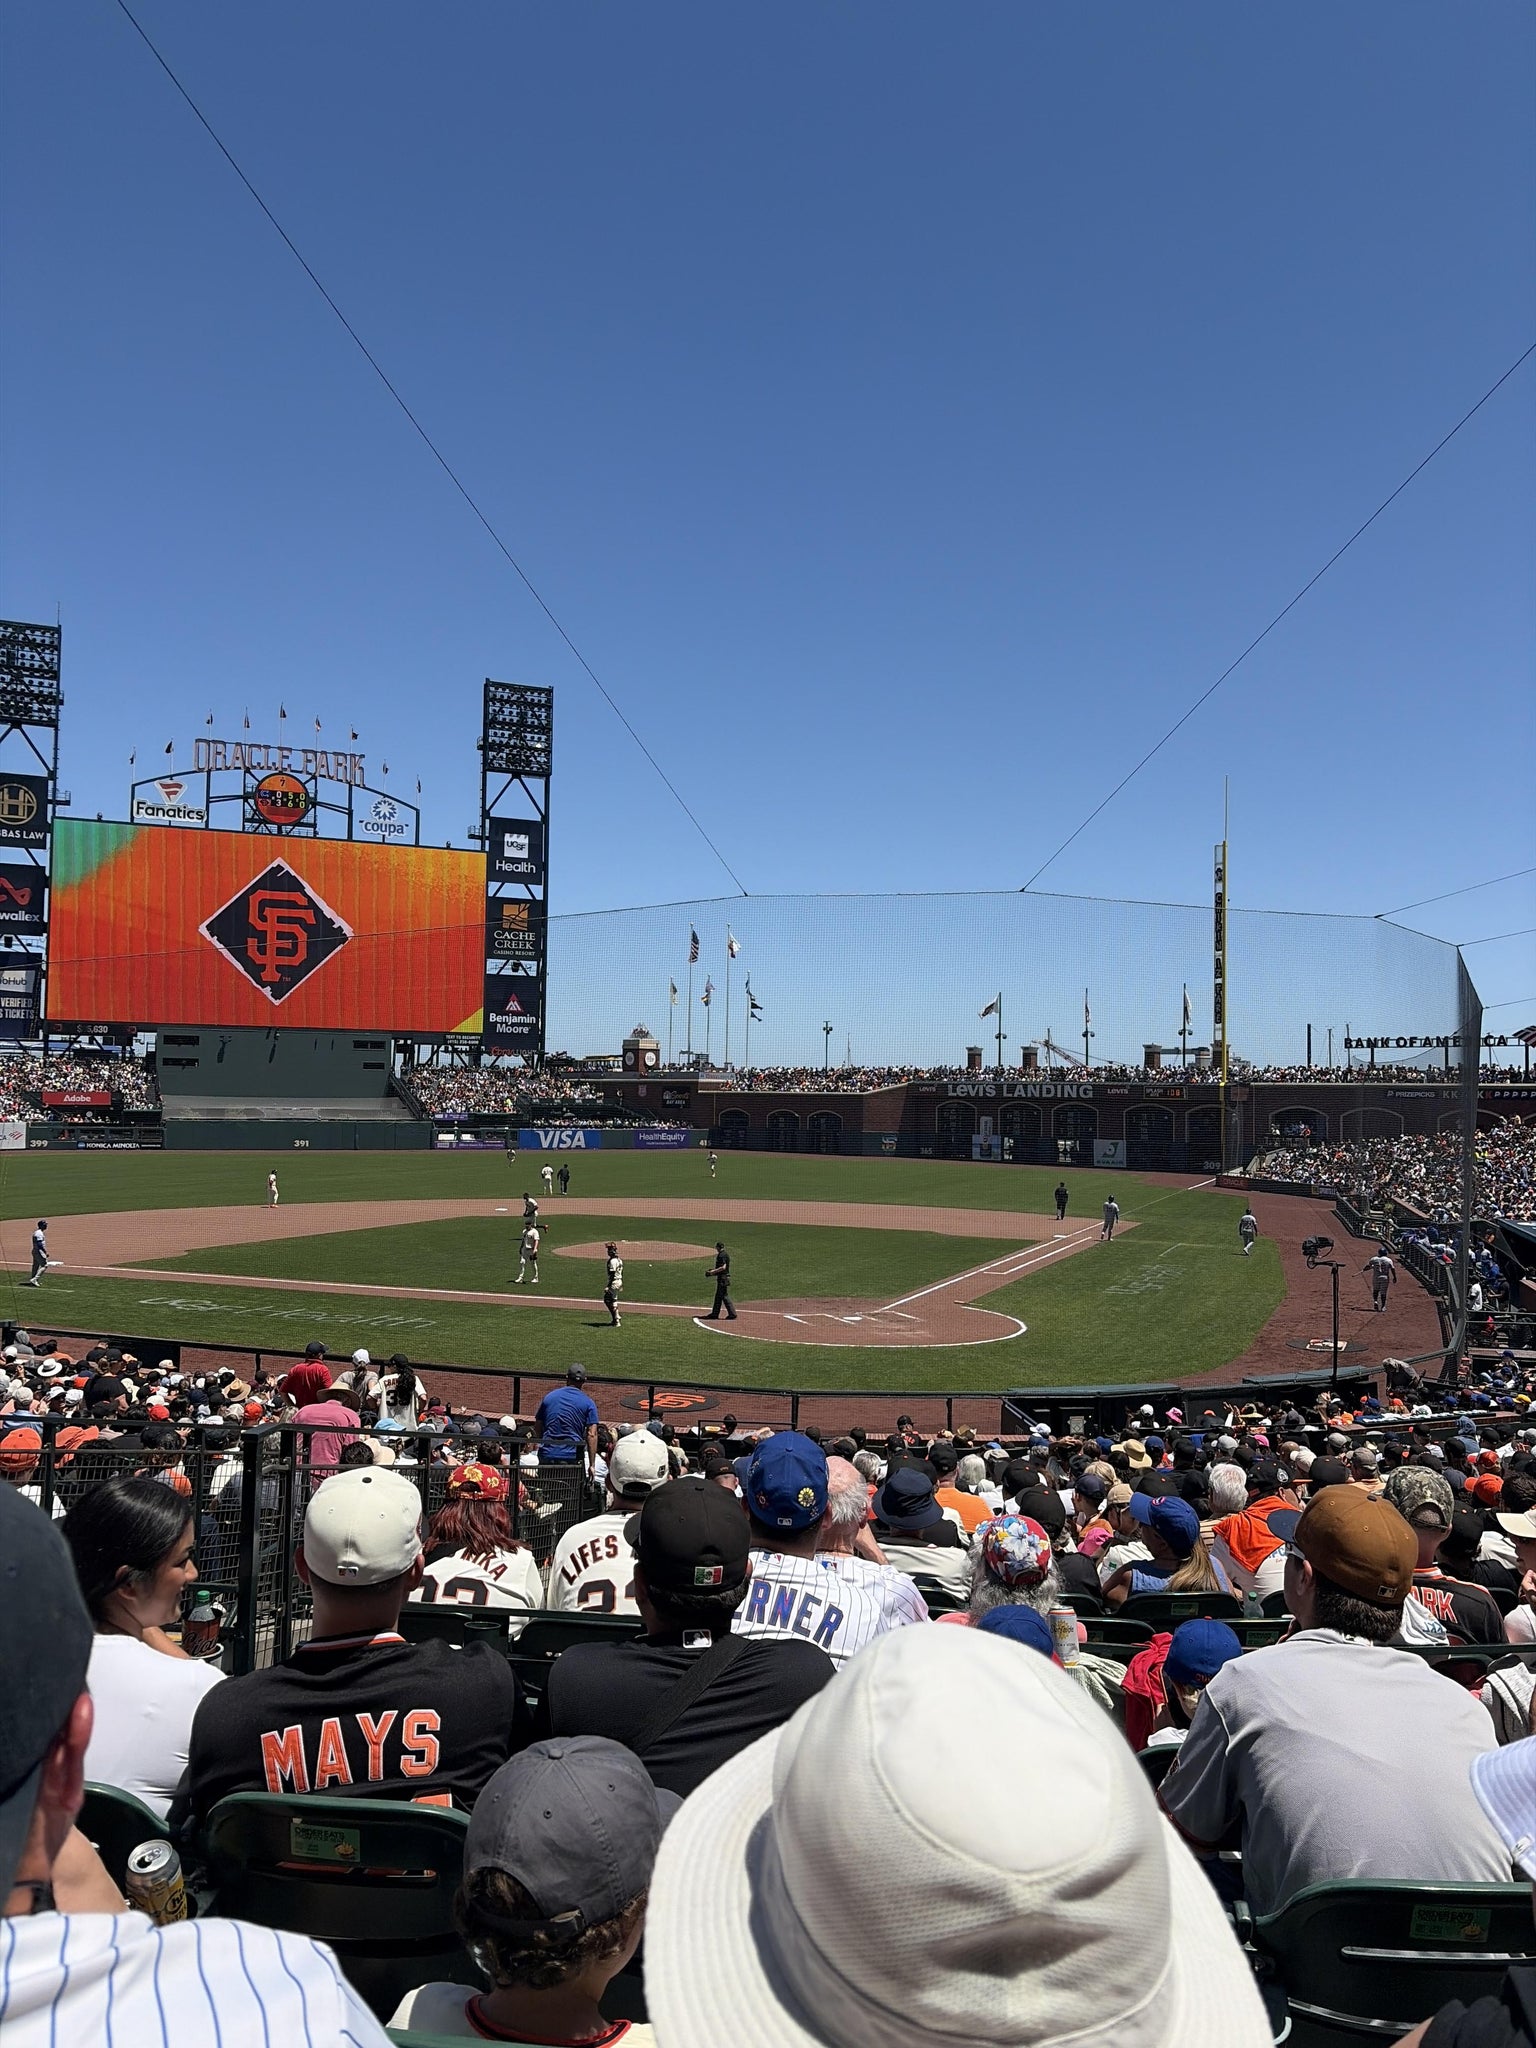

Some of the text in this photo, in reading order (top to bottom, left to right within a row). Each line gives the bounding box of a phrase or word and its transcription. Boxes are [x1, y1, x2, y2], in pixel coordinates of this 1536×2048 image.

[194, 739, 365, 787] ORACLE PARK
[136, 801, 205, 819] Fanatics
[364, 820, 405, 836] coupa
[22, 830, 45, 840] LAW
[506, 840, 527, 851] UCSF
[495, 860, 536, 873] Health
[0, 911, 40, 922] wallex
[494, 930, 536, 941] CACHE
[495, 940, 534, 950] CREEK
[1, 997, 33, 1007] VERIFIED
[5, 1009, 35, 1019] TICKETS
[489, 1013, 536, 1025] Benjamin
[496, 1023, 530, 1034] Moore
[1344, 1035, 1508, 1048] BANK OF AMECA
[1002, 1084, 1093, 1098] LANDING
[63, 1094, 92, 1102] Adobe
[293, 1139, 309, 1147] 391
[535, 1130, 586, 1149] VISA
[639, 1132, 686, 1143] HealthEquity
[30, 1140, 48, 1148] 399
[1203, 1160, 1221, 1170] 309
[233, 1305, 437, 1329] Health
[561, 1535, 619, 1586] LIFES
[1410, 1586, 1458, 1624] ARK
[743, 1579, 844, 1650] RNER
[260, 1708, 441, 1794] MAYS
